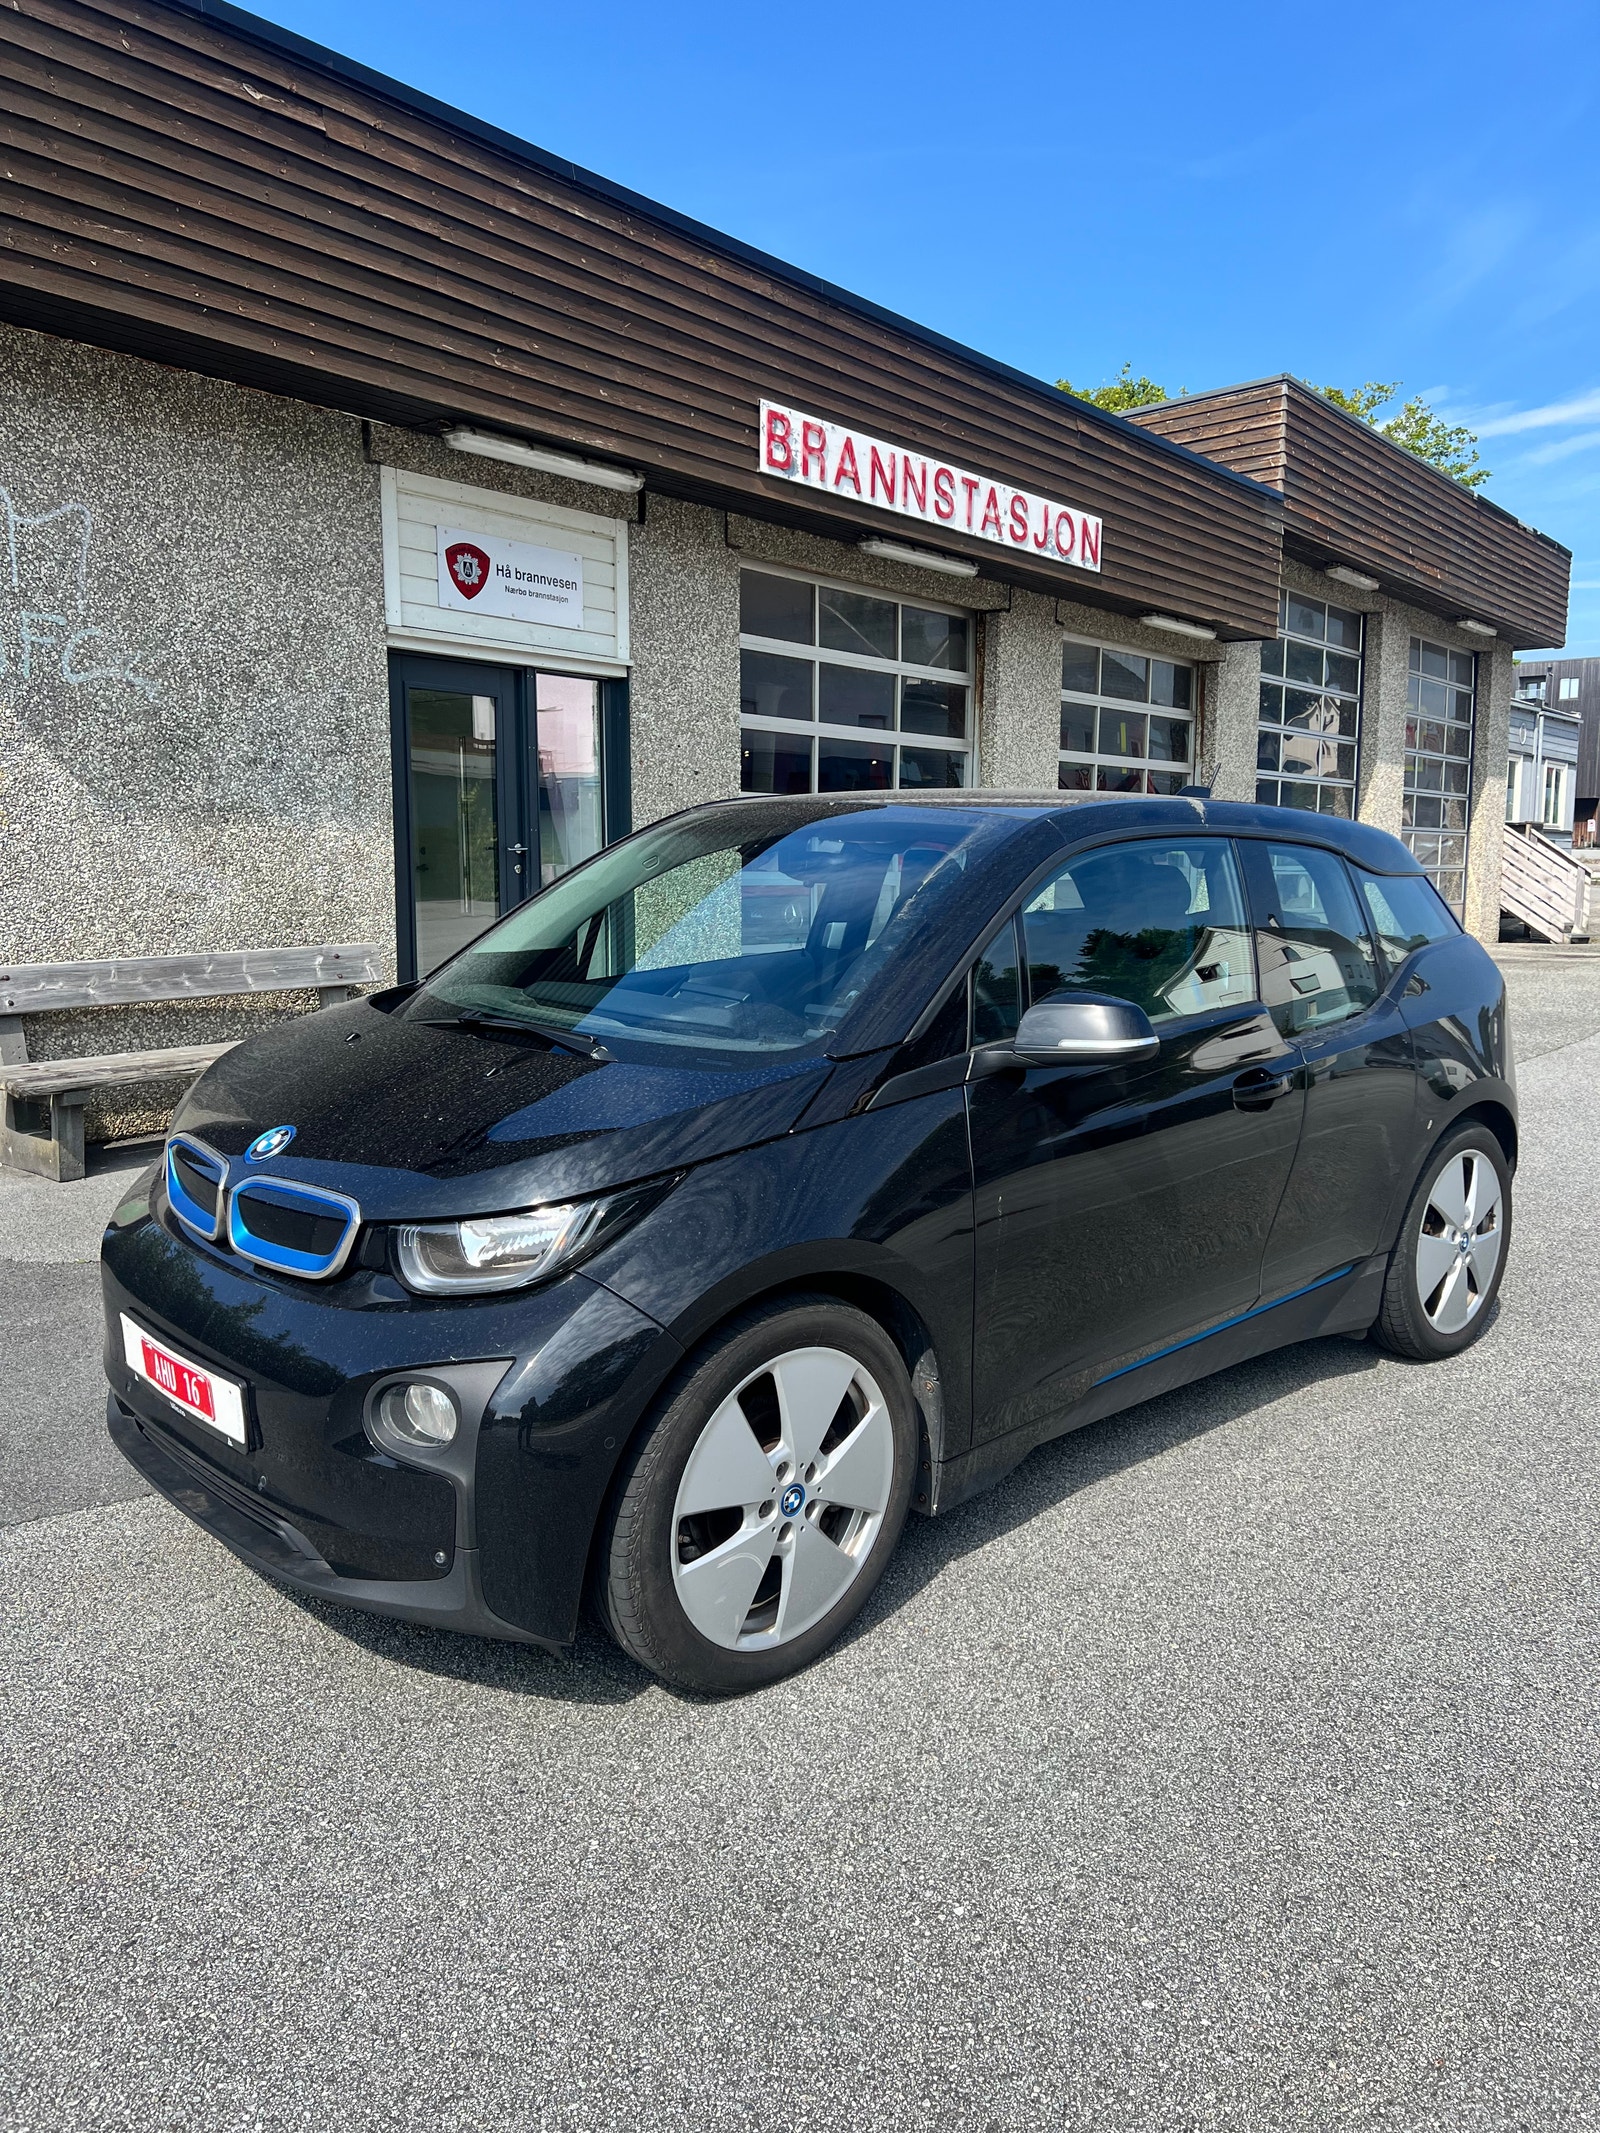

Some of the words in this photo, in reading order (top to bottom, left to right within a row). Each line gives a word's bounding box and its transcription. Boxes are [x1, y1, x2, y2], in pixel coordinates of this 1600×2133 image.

[766, 409, 1099, 565] BRANNSTASJON
[496, 564, 511, 579] Hå
[515, 568, 577, 591] brannvesen
[529, 590, 569, 604] brannstasjon
[154, 1353, 177, 1392] AHU
[183, 1372, 200, 1406] 16
